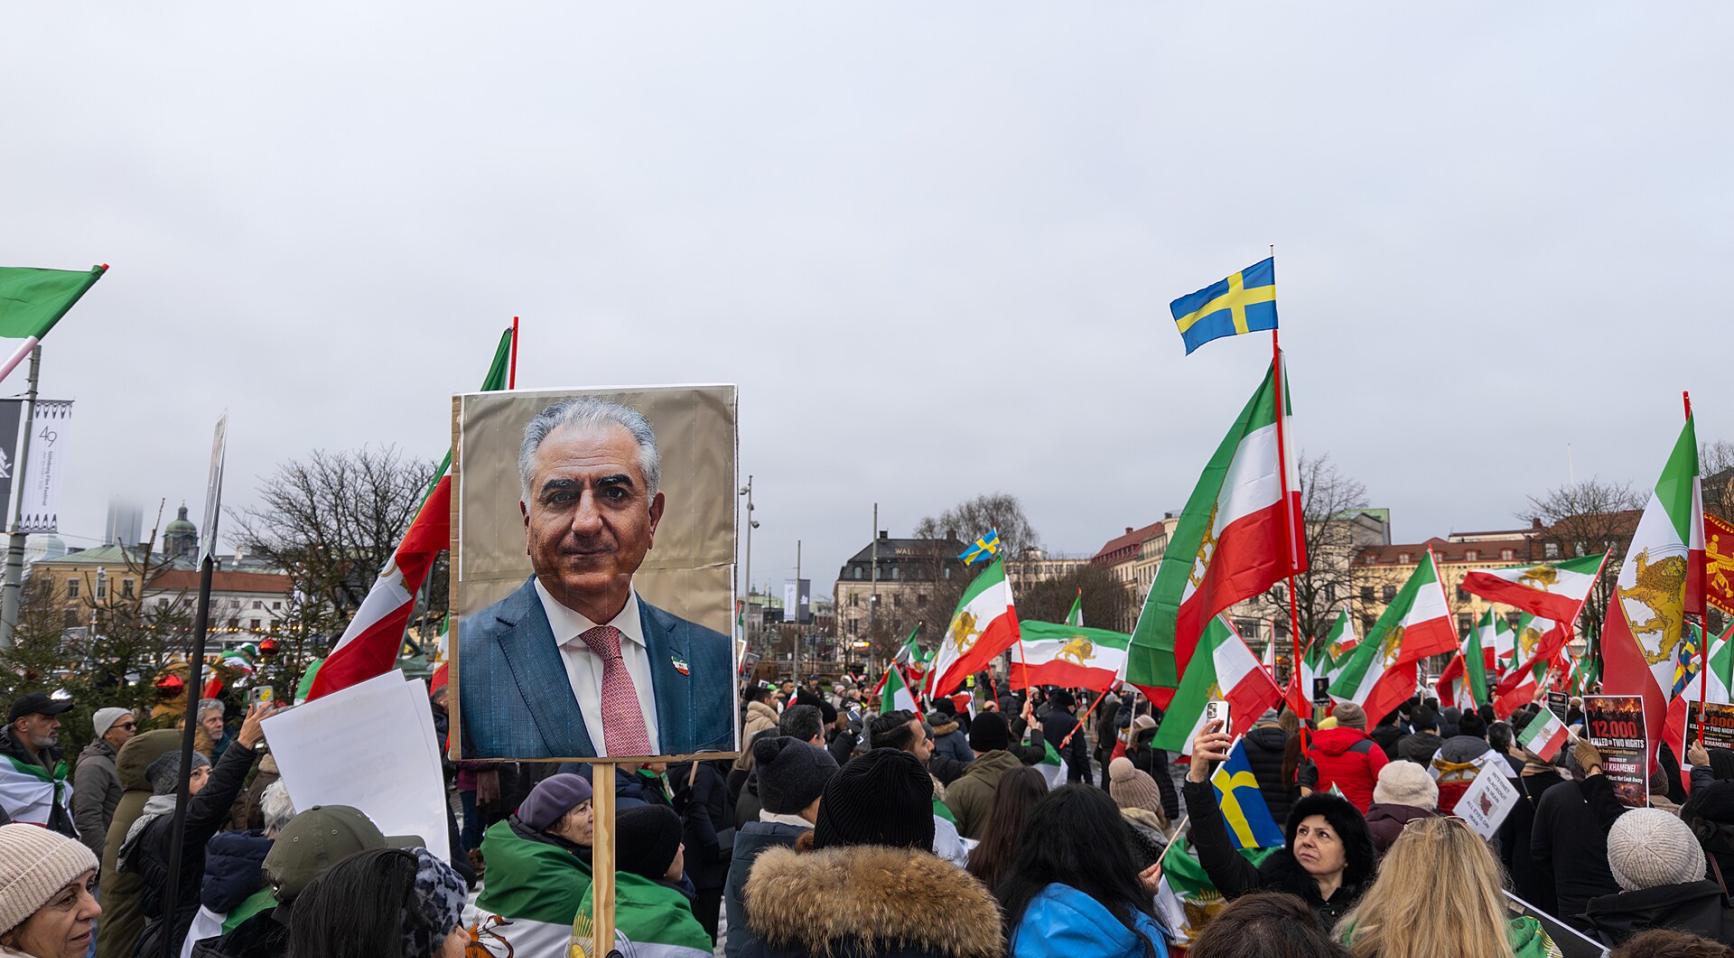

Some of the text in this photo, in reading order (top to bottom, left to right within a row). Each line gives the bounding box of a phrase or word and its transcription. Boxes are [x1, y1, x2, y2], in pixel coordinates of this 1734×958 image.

[39, 425, 57, 448] 49
[1613, 738, 1624, 747] TWO
[1625, 739, 1645, 748] NIGHTS
